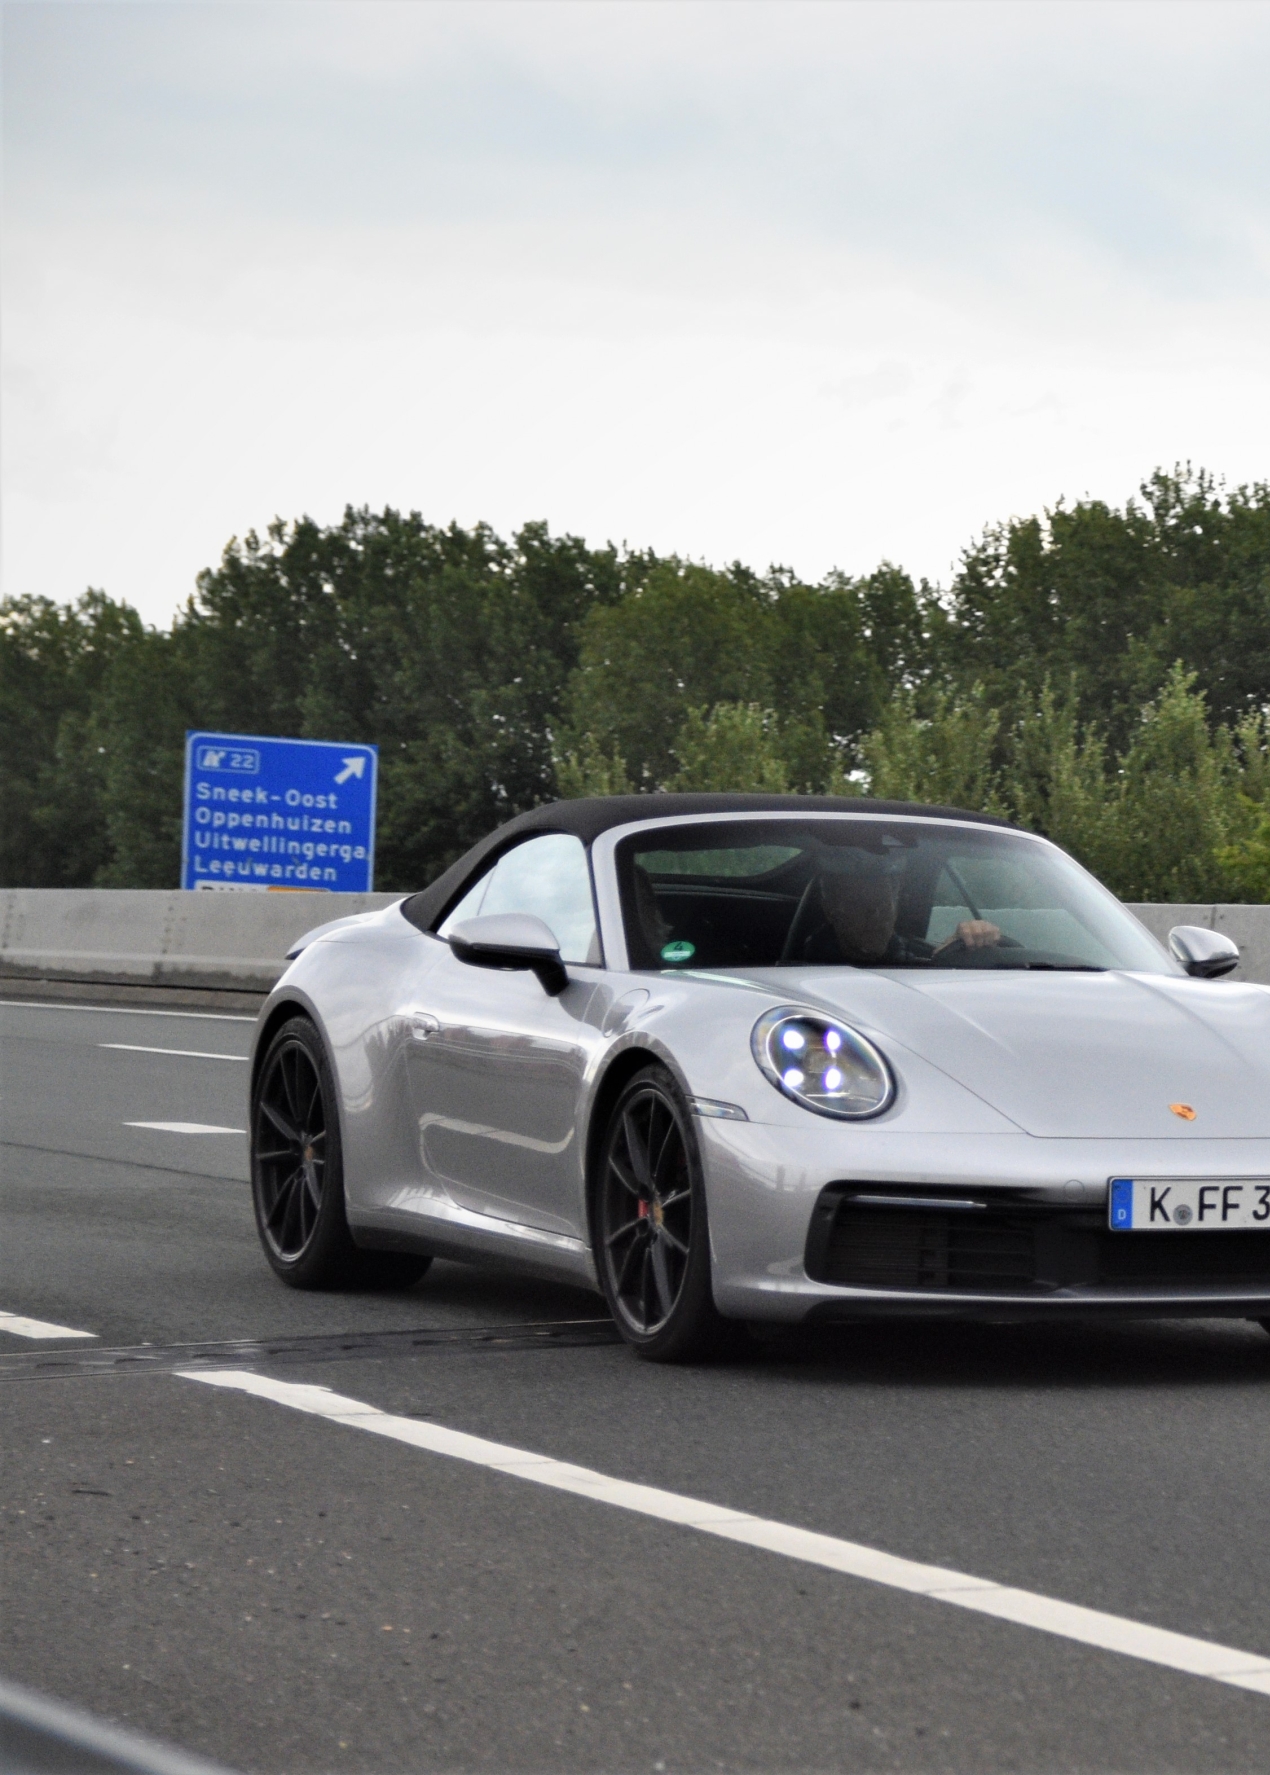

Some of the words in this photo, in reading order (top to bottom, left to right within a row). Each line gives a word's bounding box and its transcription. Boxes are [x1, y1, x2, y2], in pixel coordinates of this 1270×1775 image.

[230, 754, 255, 769] 22
[196, 782, 338, 809] Sneek-Oost
[195, 807, 352, 834] Oppenhuizen
[194, 831, 366, 862] Uitwellingerga
[194, 855, 338, 882] Leeuwarden
[1117, 1209, 1127, 1220] D
[1149, 1186, 1172, 1222] K
[1197, 1185, 1243, 1221] FF
